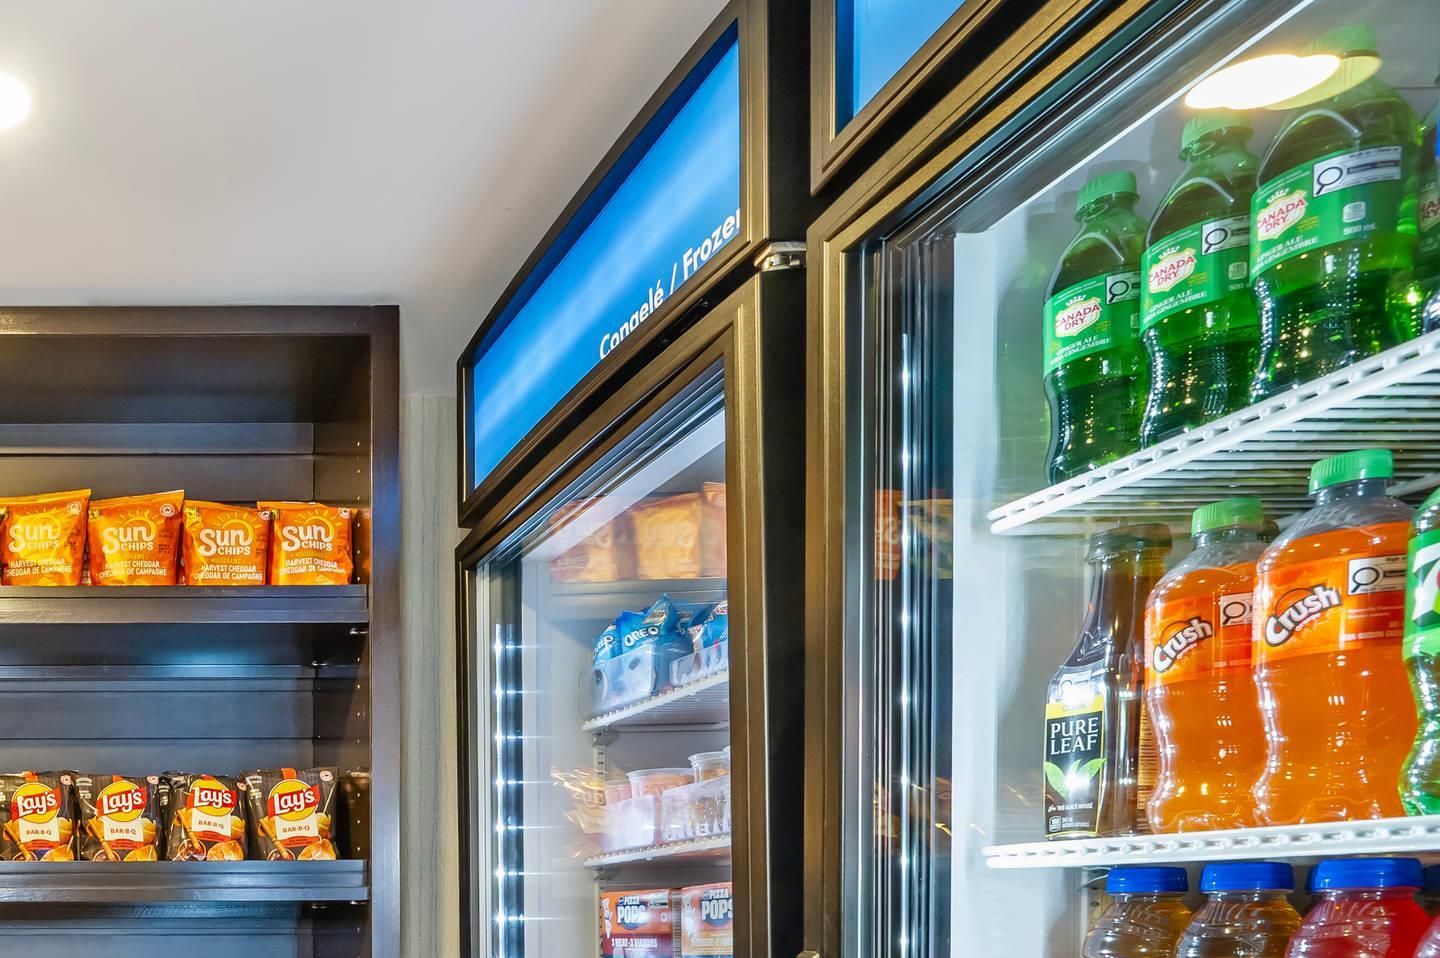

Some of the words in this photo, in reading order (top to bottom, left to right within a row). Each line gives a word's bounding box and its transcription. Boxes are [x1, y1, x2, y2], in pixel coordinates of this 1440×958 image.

[1157, 271, 1179, 287] DRY
[1064, 315, 1088, 331] DRY
[9, 522, 62, 553] Sun
[27, 540, 60, 551] CHIPS
[102, 525, 157, 554] Sun
[121, 541, 154, 551] CHIPS
[199, 528, 254, 557] Sun
[282, 525, 335, 552] Sun
[301, 540, 333, 551] CHIPS
[218, 546, 251, 556] CHIPS
[231, 572, 263, 581] CAMPAGNE
[1265, 586, 1341, 647] Crush
[623, 627, 659, 647] OREO
[1152, 617, 1214, 673] Crush
[1051, 717, 1099, 739] PURE
[1050, 734, 1098, 755] LEAF
[17, 792, 56, 817] Lay's
[103, 789, 142, 814] Lay's
[194, 787, 232, 808] Lay's
[274, 789, 315, 814] Lay's
